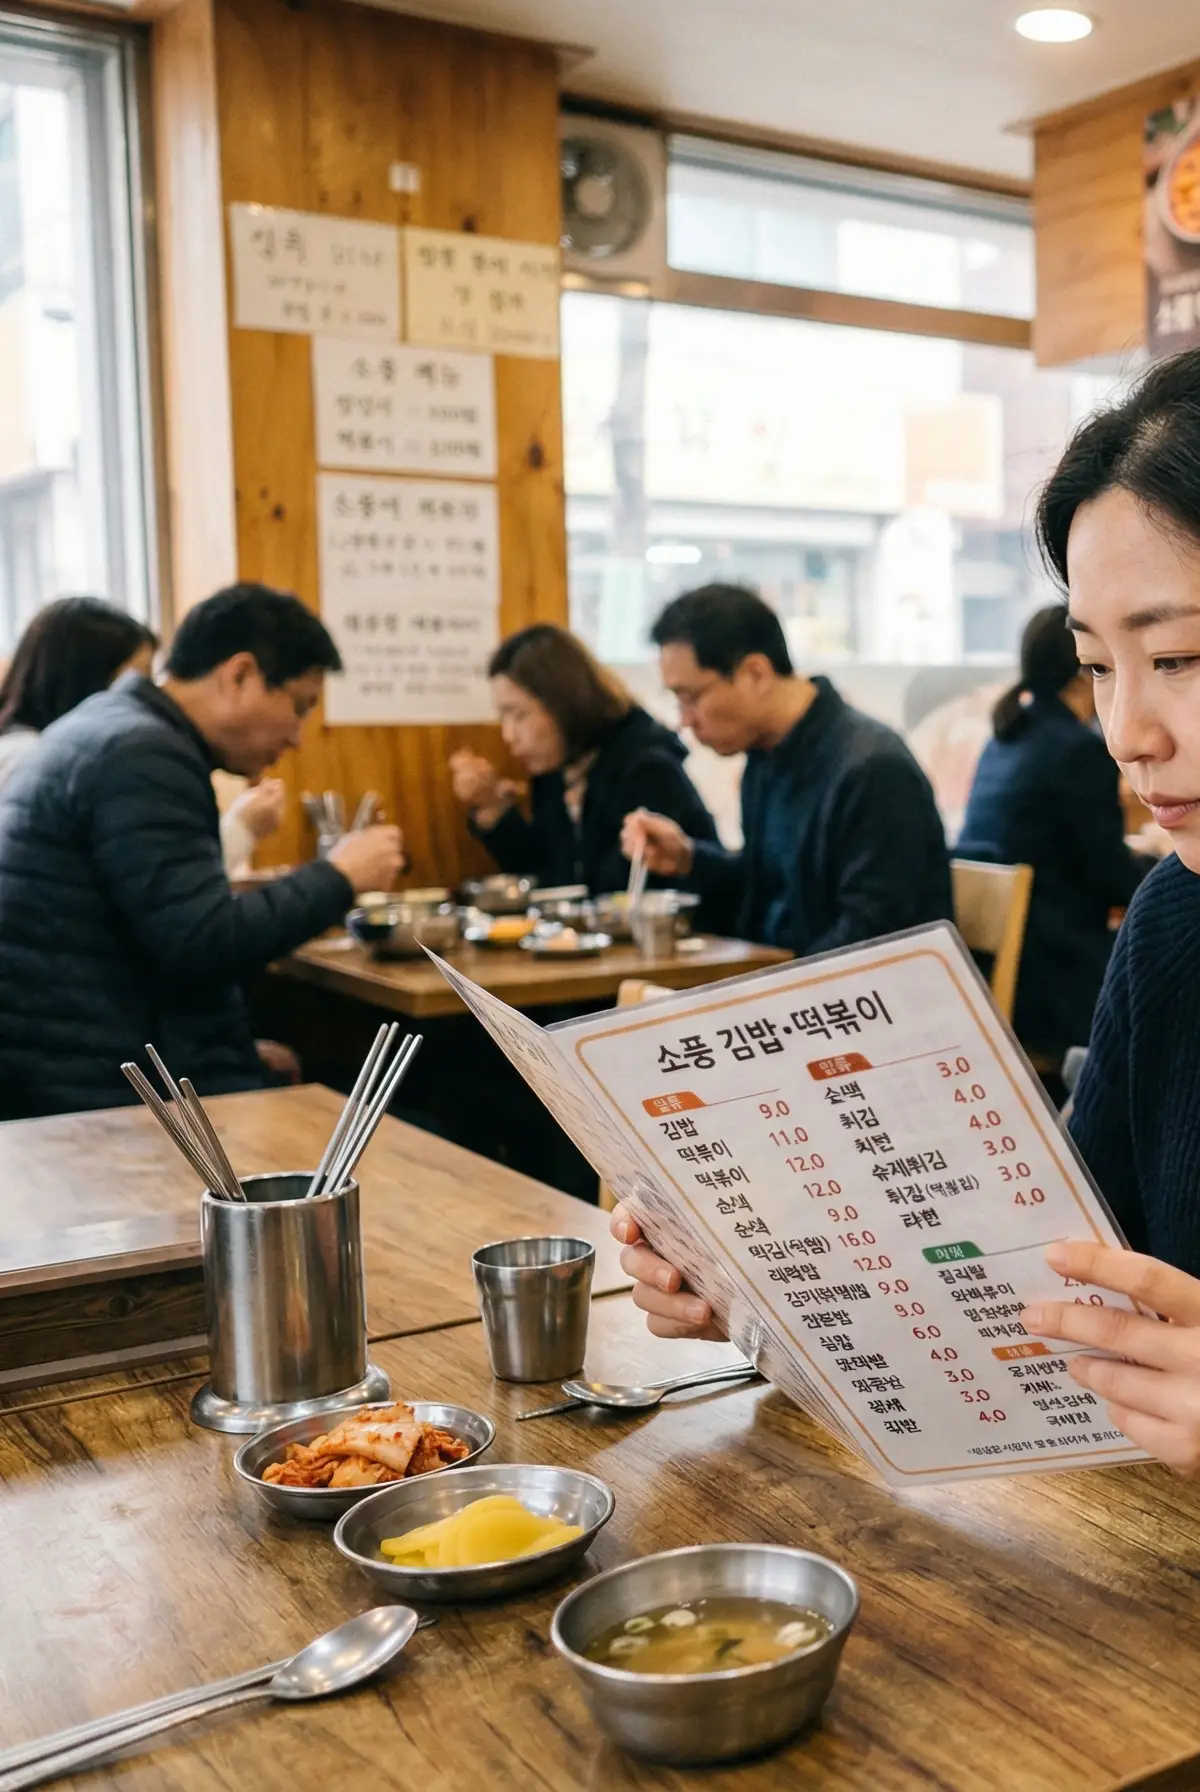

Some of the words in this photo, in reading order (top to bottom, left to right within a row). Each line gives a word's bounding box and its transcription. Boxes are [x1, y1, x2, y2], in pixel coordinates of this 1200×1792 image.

[658, 1035, 716, 1074] 소풍
[716, 990, 893, 1062] 김밥·떡볶이
[936, 1056, 970, 1078] 3.0
[954, 1084, 986, 1104] 4.0
[659, 1117, 699, 1141] 김밥
[759, 1100, 790, 1119] 9.0
[969, 1109, 1002, 1130] 4.0
[769, 1126, 809, 1147] 11.0
[983, 1136, 1017, 1156] 3.0
[785, 1153, 825, 1173] 12.0
[997, 1162, 1031, 1182] 3.0
[803, 1179, 842, 1198] 12.0
[1014, 1187, 1046, 1206] 4.0
[827, 1205, 859, 1222] 9.0
[837, 1230, 876, 1248] 16.0
[853, 1255, 892, 1272] 12.0
[878, 1279, 909, 1295] 9.0
[912, 1325, 941, 1339] 6.0
[931, 1347, 958, 1361] 4.0
[944, 1368, 974, 1383] 3.0
[960, 1389, 990, 1403] 3.0
[979, 1409, 1006, 1423] 4.0
